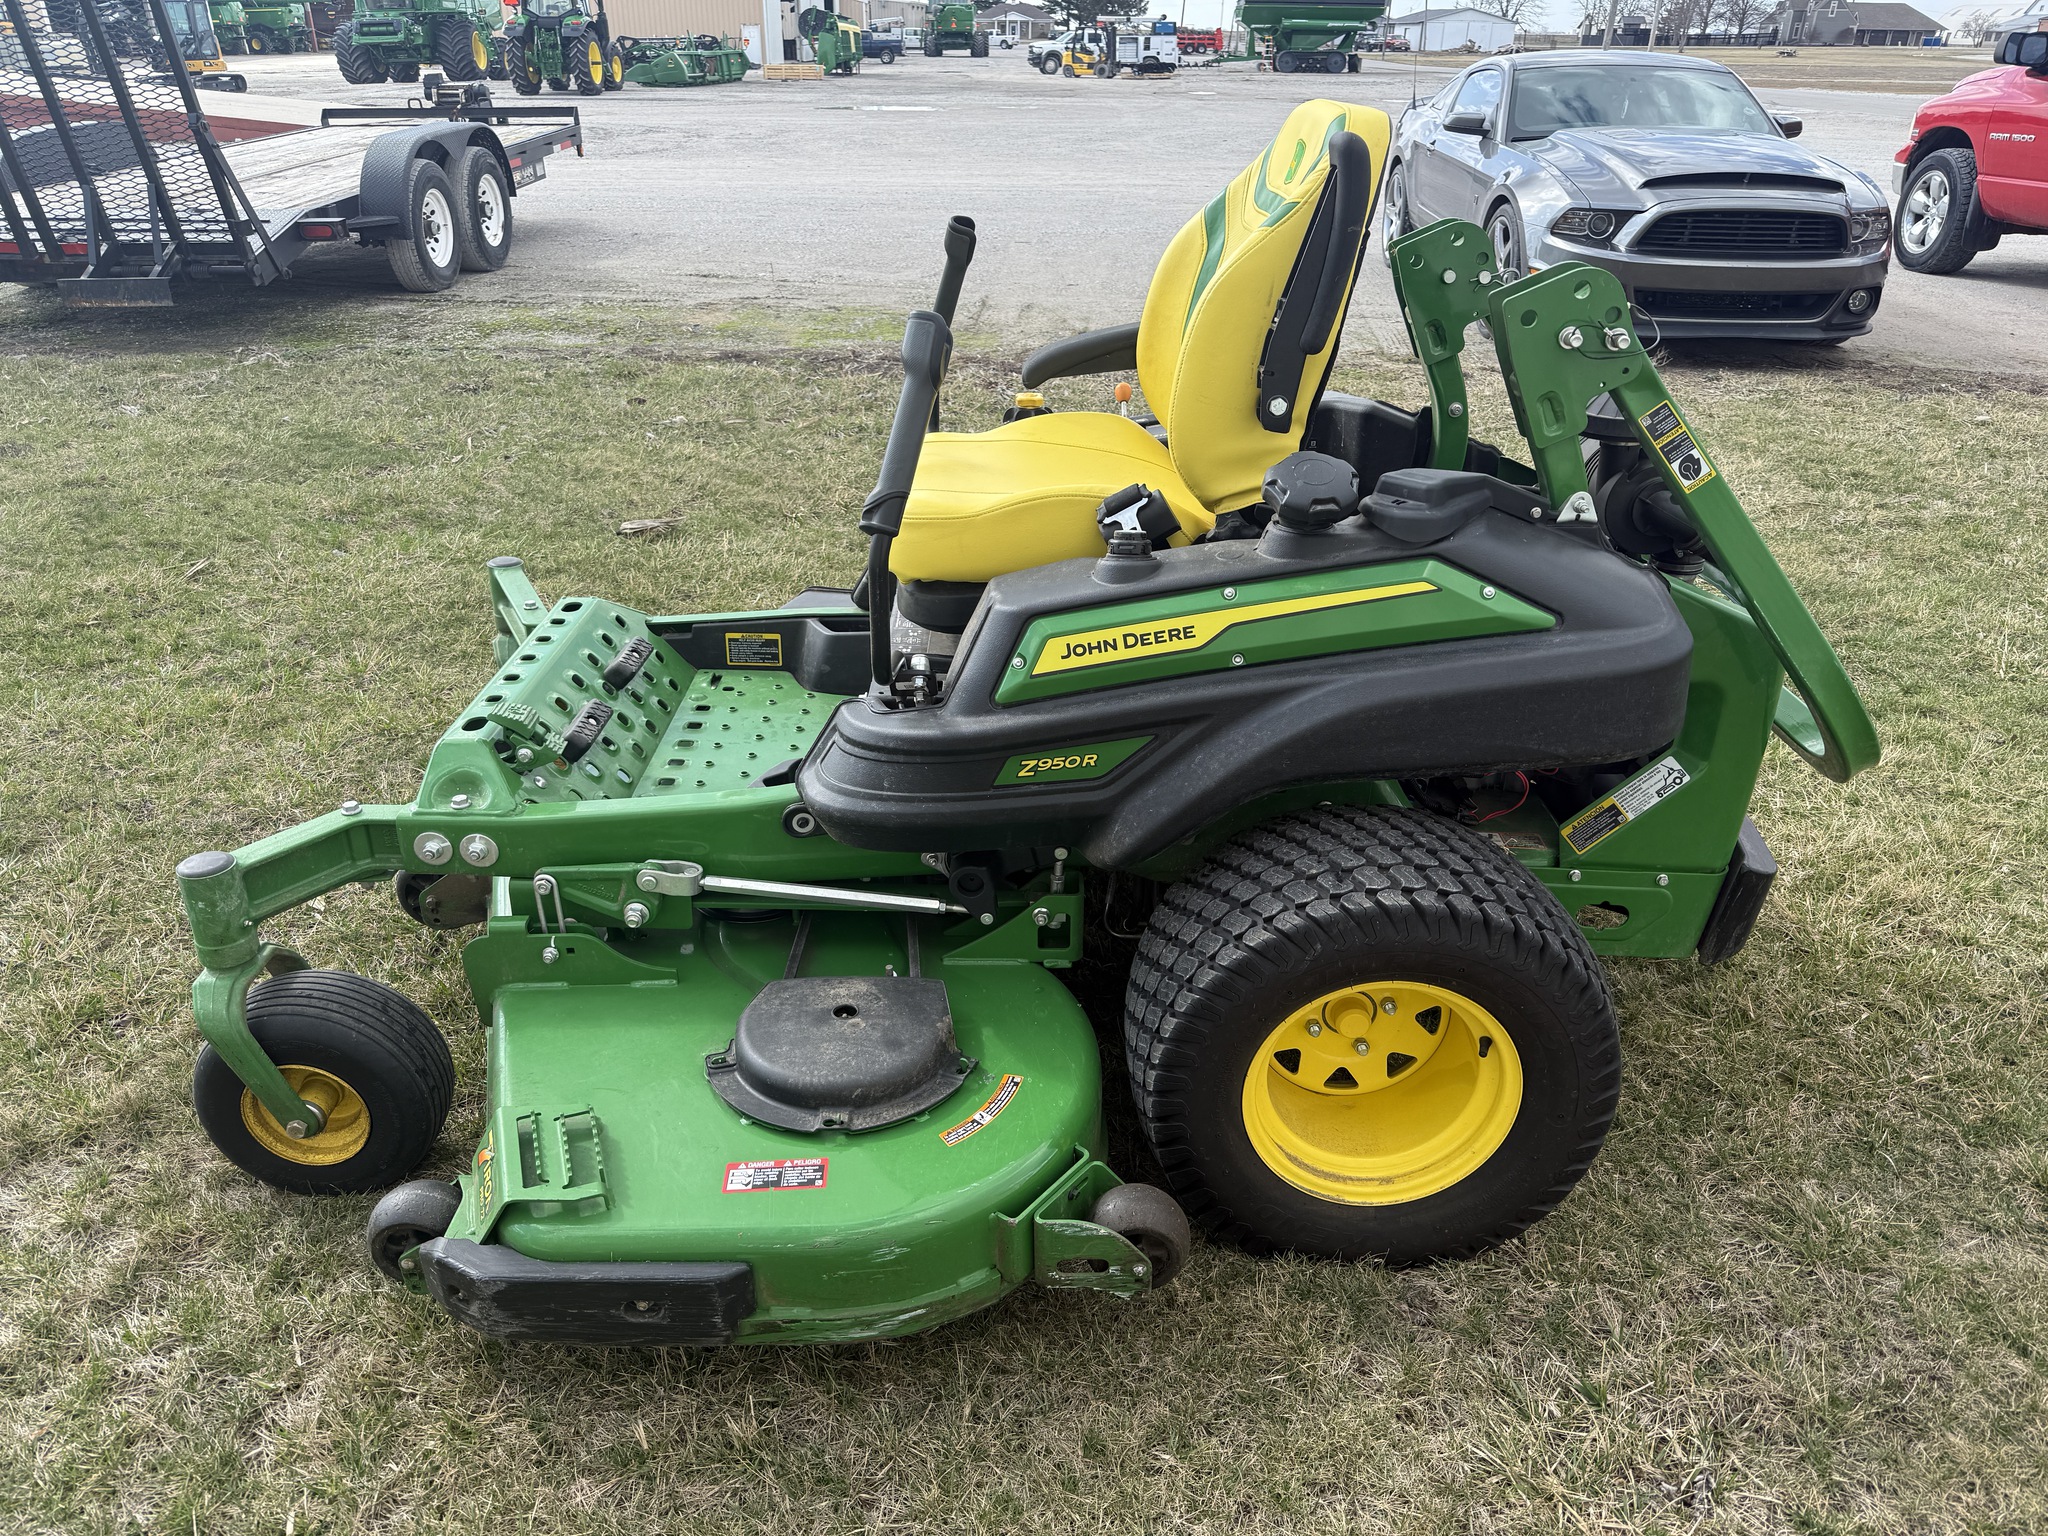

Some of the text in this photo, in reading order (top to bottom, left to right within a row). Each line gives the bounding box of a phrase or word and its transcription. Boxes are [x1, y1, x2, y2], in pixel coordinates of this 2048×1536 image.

[1990, 133, 2036, 142] RAM 1500
[1687, 475, 1709, 491] CAUTION
[1061, 625, 1196, 660] JOHN DEERE
[1018, 754, 1098, 777] Z950R
